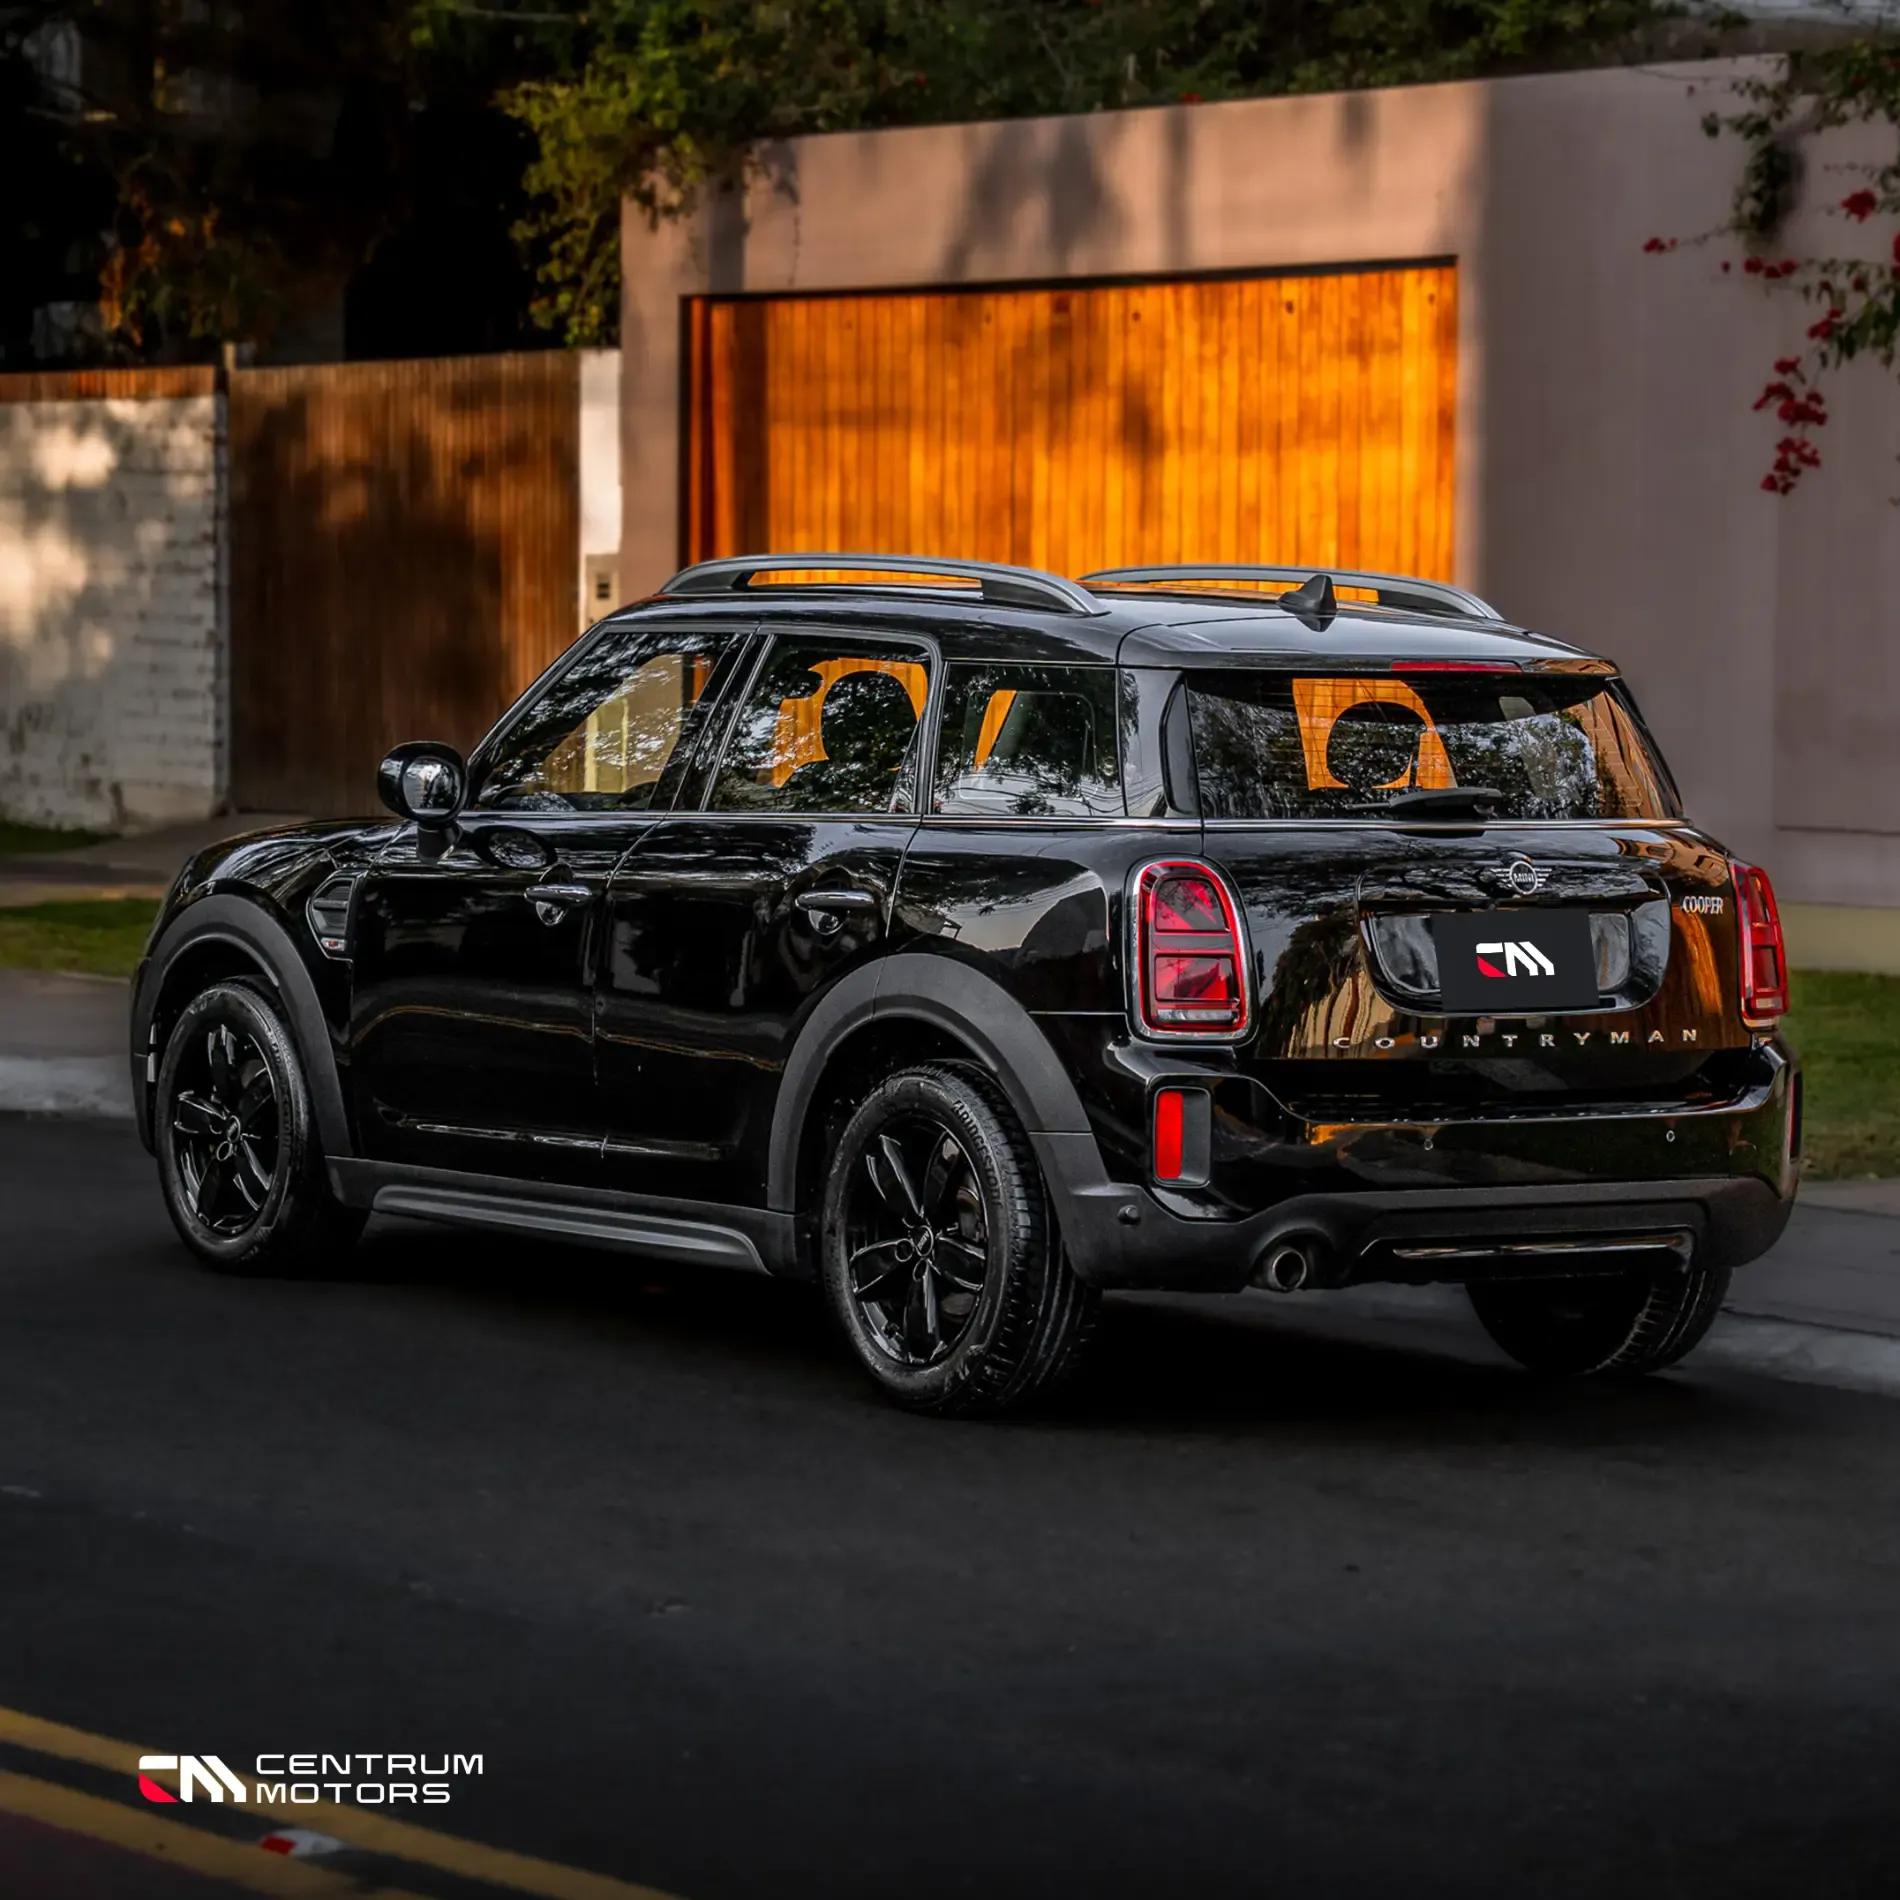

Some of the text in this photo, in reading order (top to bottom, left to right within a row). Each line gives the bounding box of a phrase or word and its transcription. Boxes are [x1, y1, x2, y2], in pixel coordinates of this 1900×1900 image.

[1513, 872, 1535, 882] MINI
[1682, 896, 1723, 914] COOPER
[1332, 1029, 1698, 1049] COUNTRYMAN
